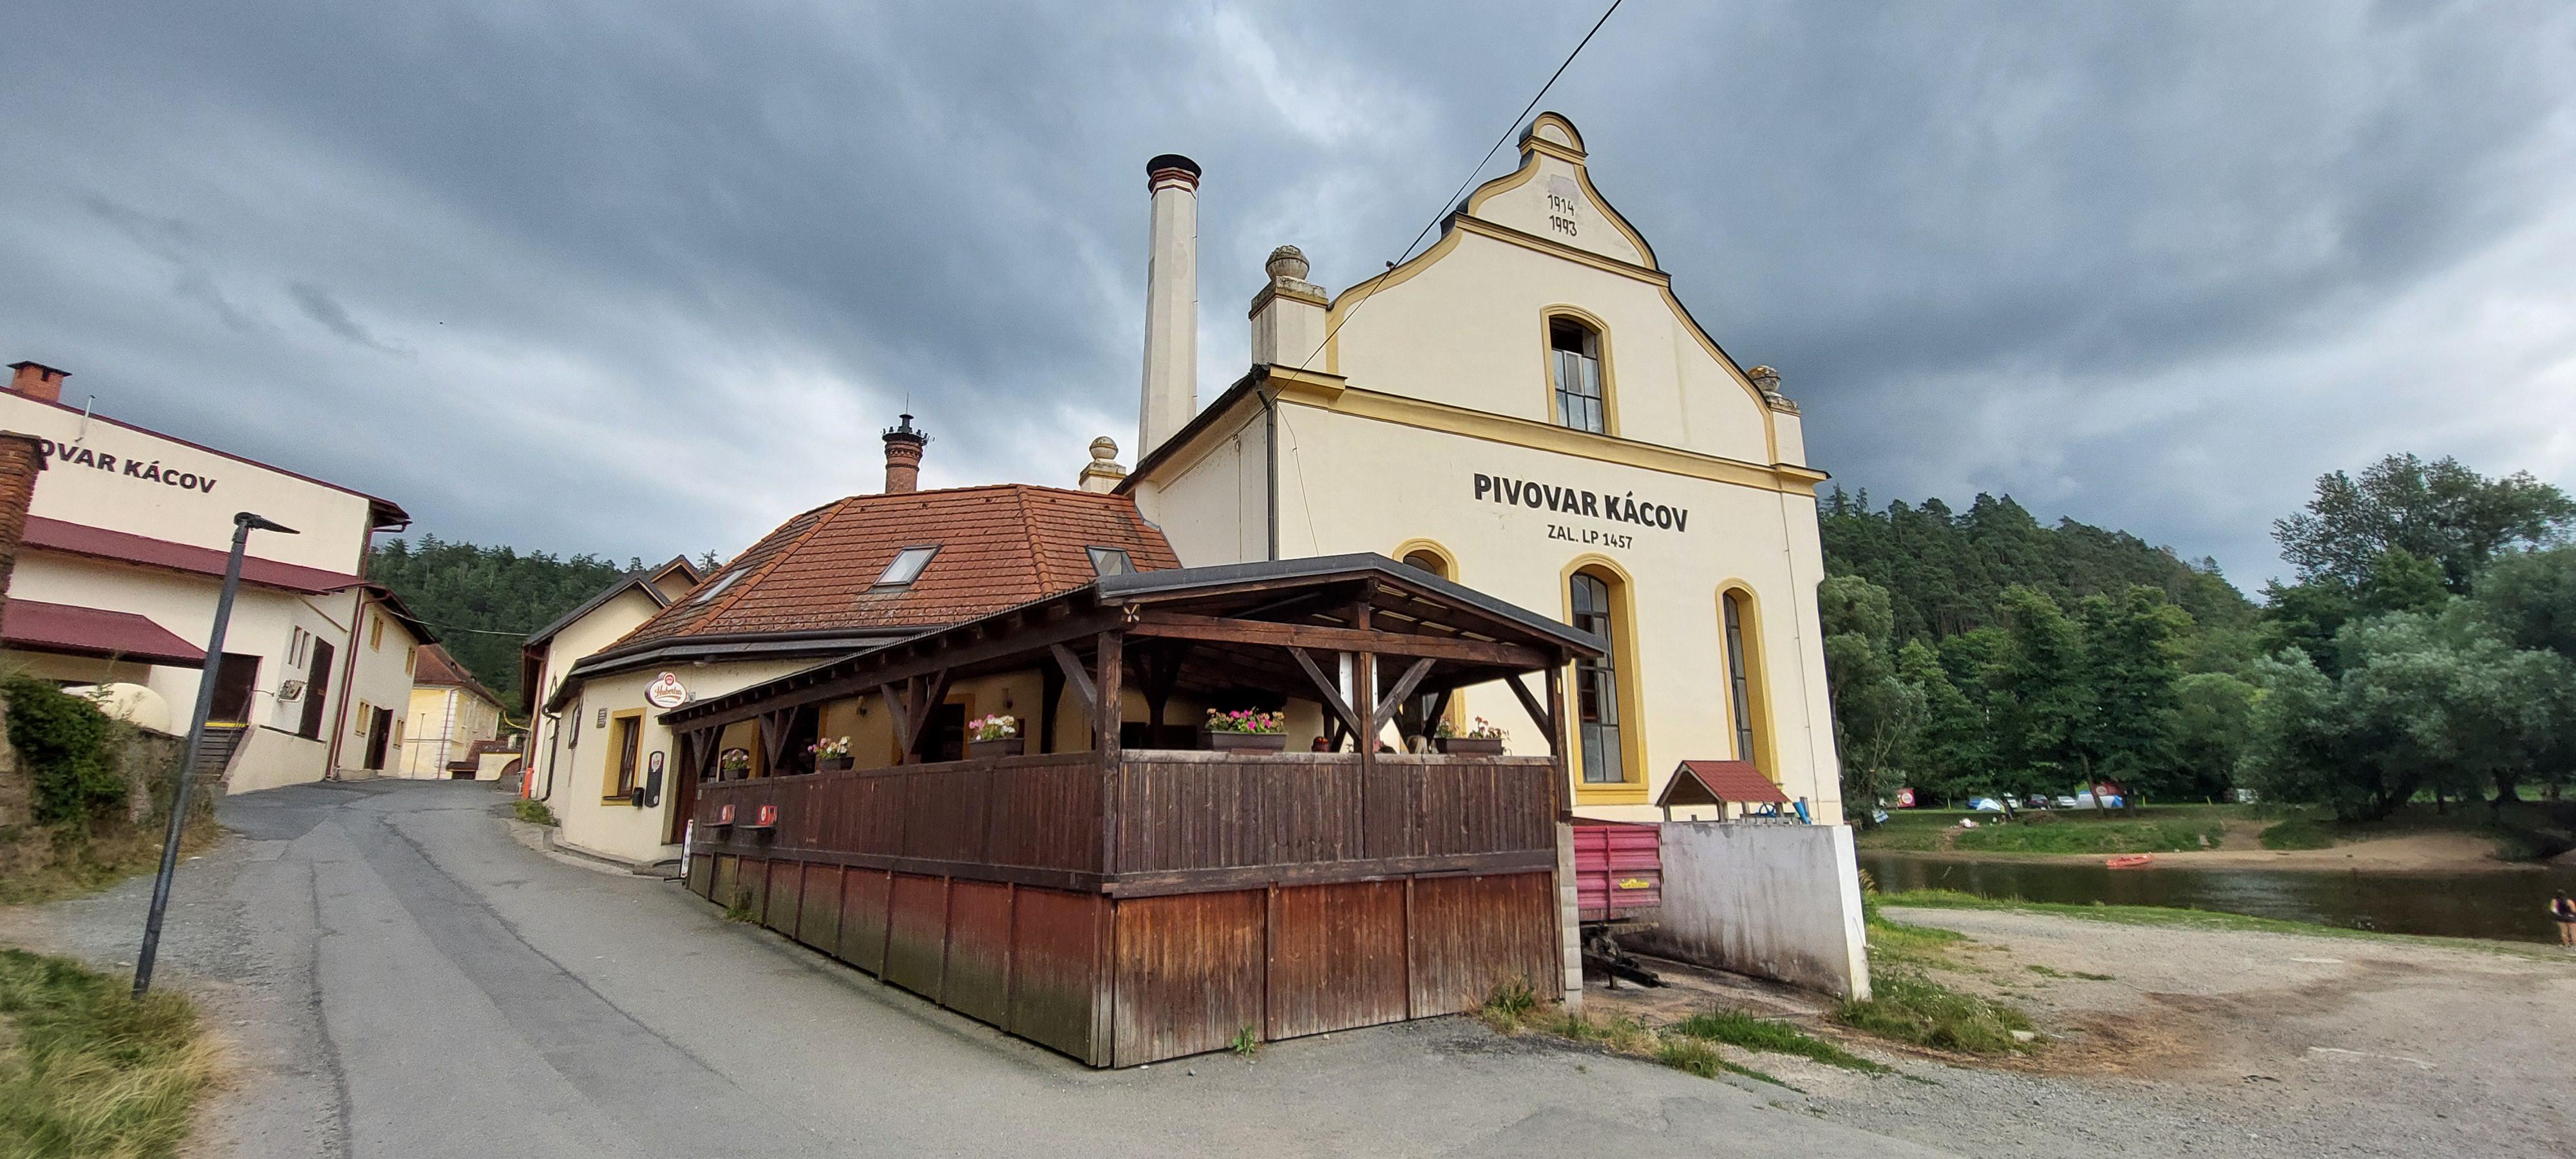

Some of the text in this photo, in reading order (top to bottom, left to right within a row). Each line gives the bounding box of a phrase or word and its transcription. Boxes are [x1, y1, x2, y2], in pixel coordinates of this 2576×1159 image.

[1547, 194, 1575, 216] 1914
[1549, 214, 1577, 236] 1993
[123, 459, 218, 494] KÁCOV
[1473, 473, 1688, 532] PIVOVAR KÁCOV
[1547, 524, 1633, 549] ZAL. LP 1457
